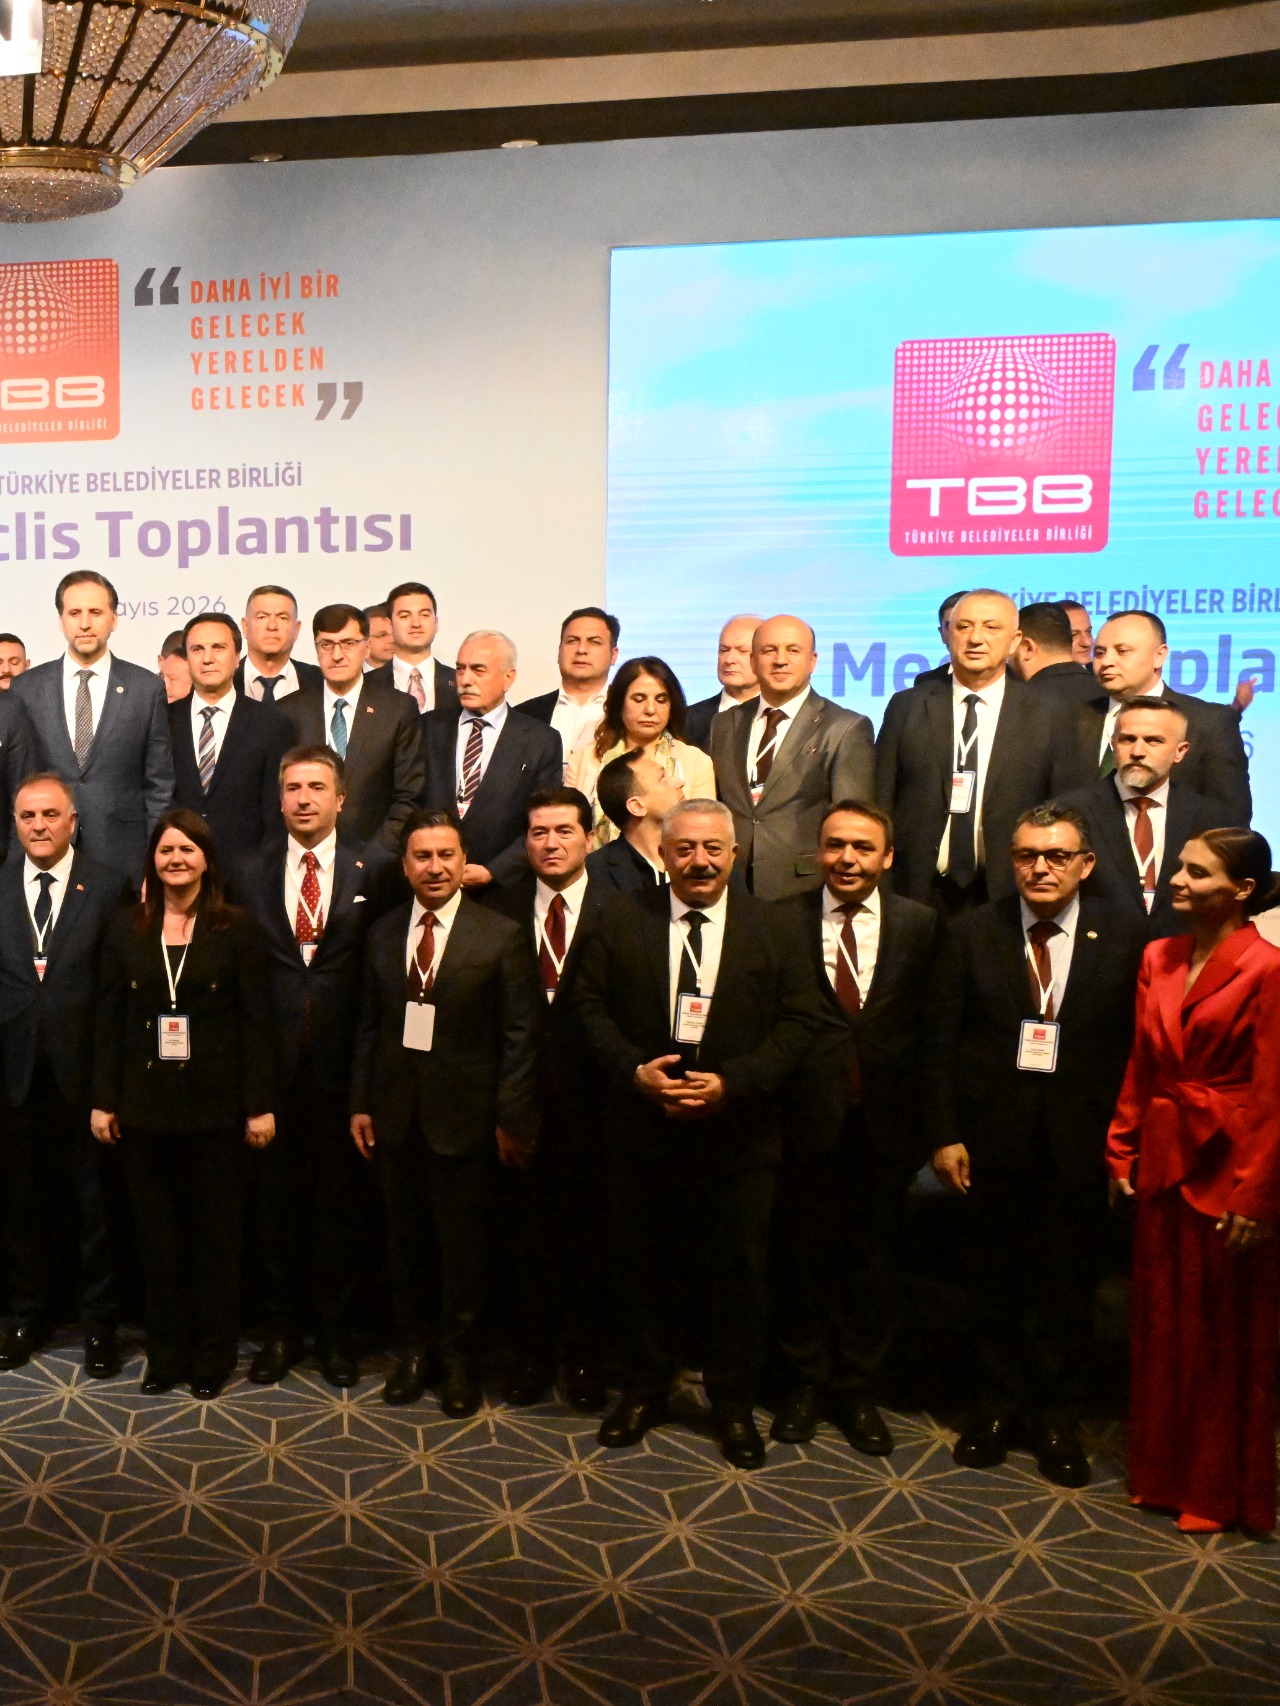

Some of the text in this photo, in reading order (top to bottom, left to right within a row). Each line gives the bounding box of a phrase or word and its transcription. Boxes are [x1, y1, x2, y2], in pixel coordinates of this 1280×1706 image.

[190, 269, 339, 304] DAHA İYİ BİR
[190, 311, 305, 339] GELECEK
[190, 346, 324, 375] YERELDEN
[1198, 358, 1272, 390] DAHA
[191, 383, 305, 410] GELECEK
[68, 417, 107, 431] BİRLİĞİ
[1197, 402, 1280, 433] GELE
[1195, 446, 1280, 475] YERE
[86, 466, 222, 493] BELEDİYELER
[227, 461, 303, 489] BİRLİĞİ
[906, 473, 1094, 517] TBB
[95, 505, 413, 569] Toplantısı
[904, 524, 1093, 544] TÜRKİYE BELEDİYELER BİRLİĞİ
[117, 595, 227, 620] ayıs 2026
